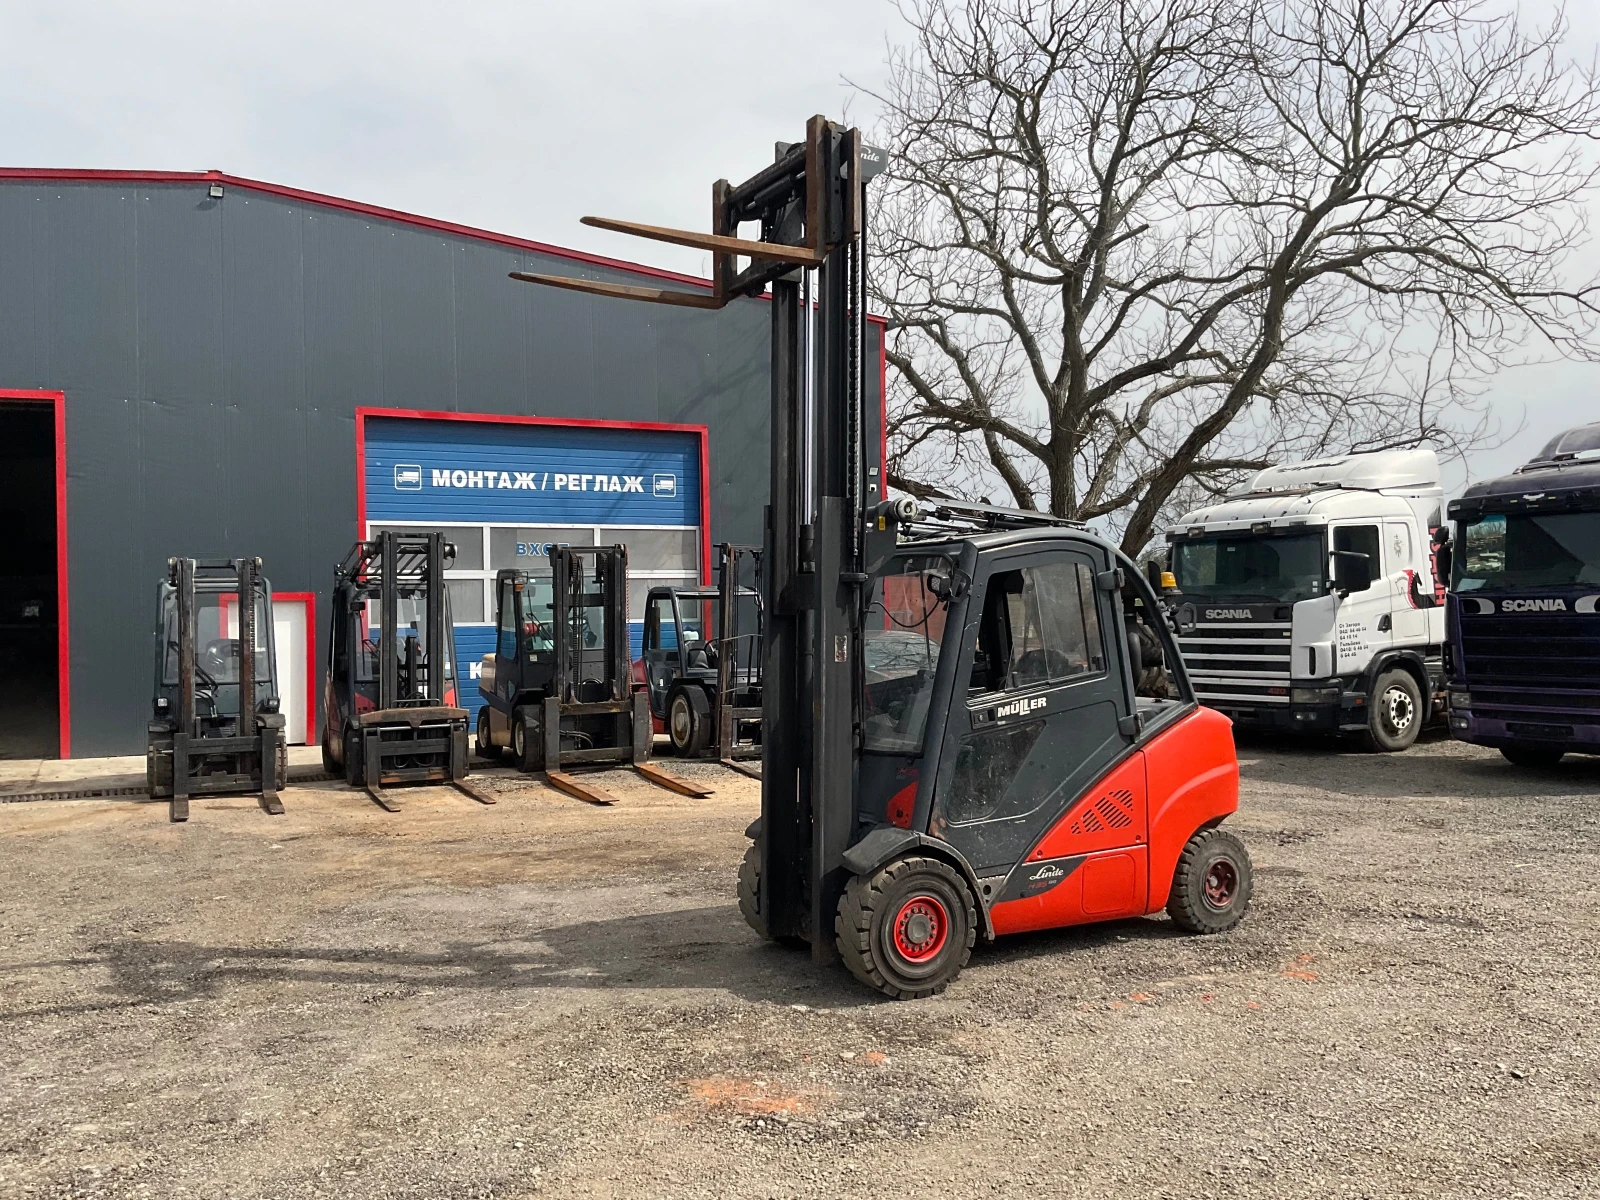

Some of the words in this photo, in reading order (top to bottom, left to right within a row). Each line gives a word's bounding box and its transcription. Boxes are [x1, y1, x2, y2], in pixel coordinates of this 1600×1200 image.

[861, 146, 880, 162] nde
[432, 469, 537, 490] МОНТАЖ
[541, 473, 549, 491] /
[554, 473, 645, 493] РЕГЛАЖ
[516, 542, 570, 557] ВХО
[1501, 599, 1567, 612] SCANIA
[1205, 609, 1252, 619] SCANIA
[997, 697, 1047, 718] MÜLLER
[1029, 865, 1064, 881] Linde
